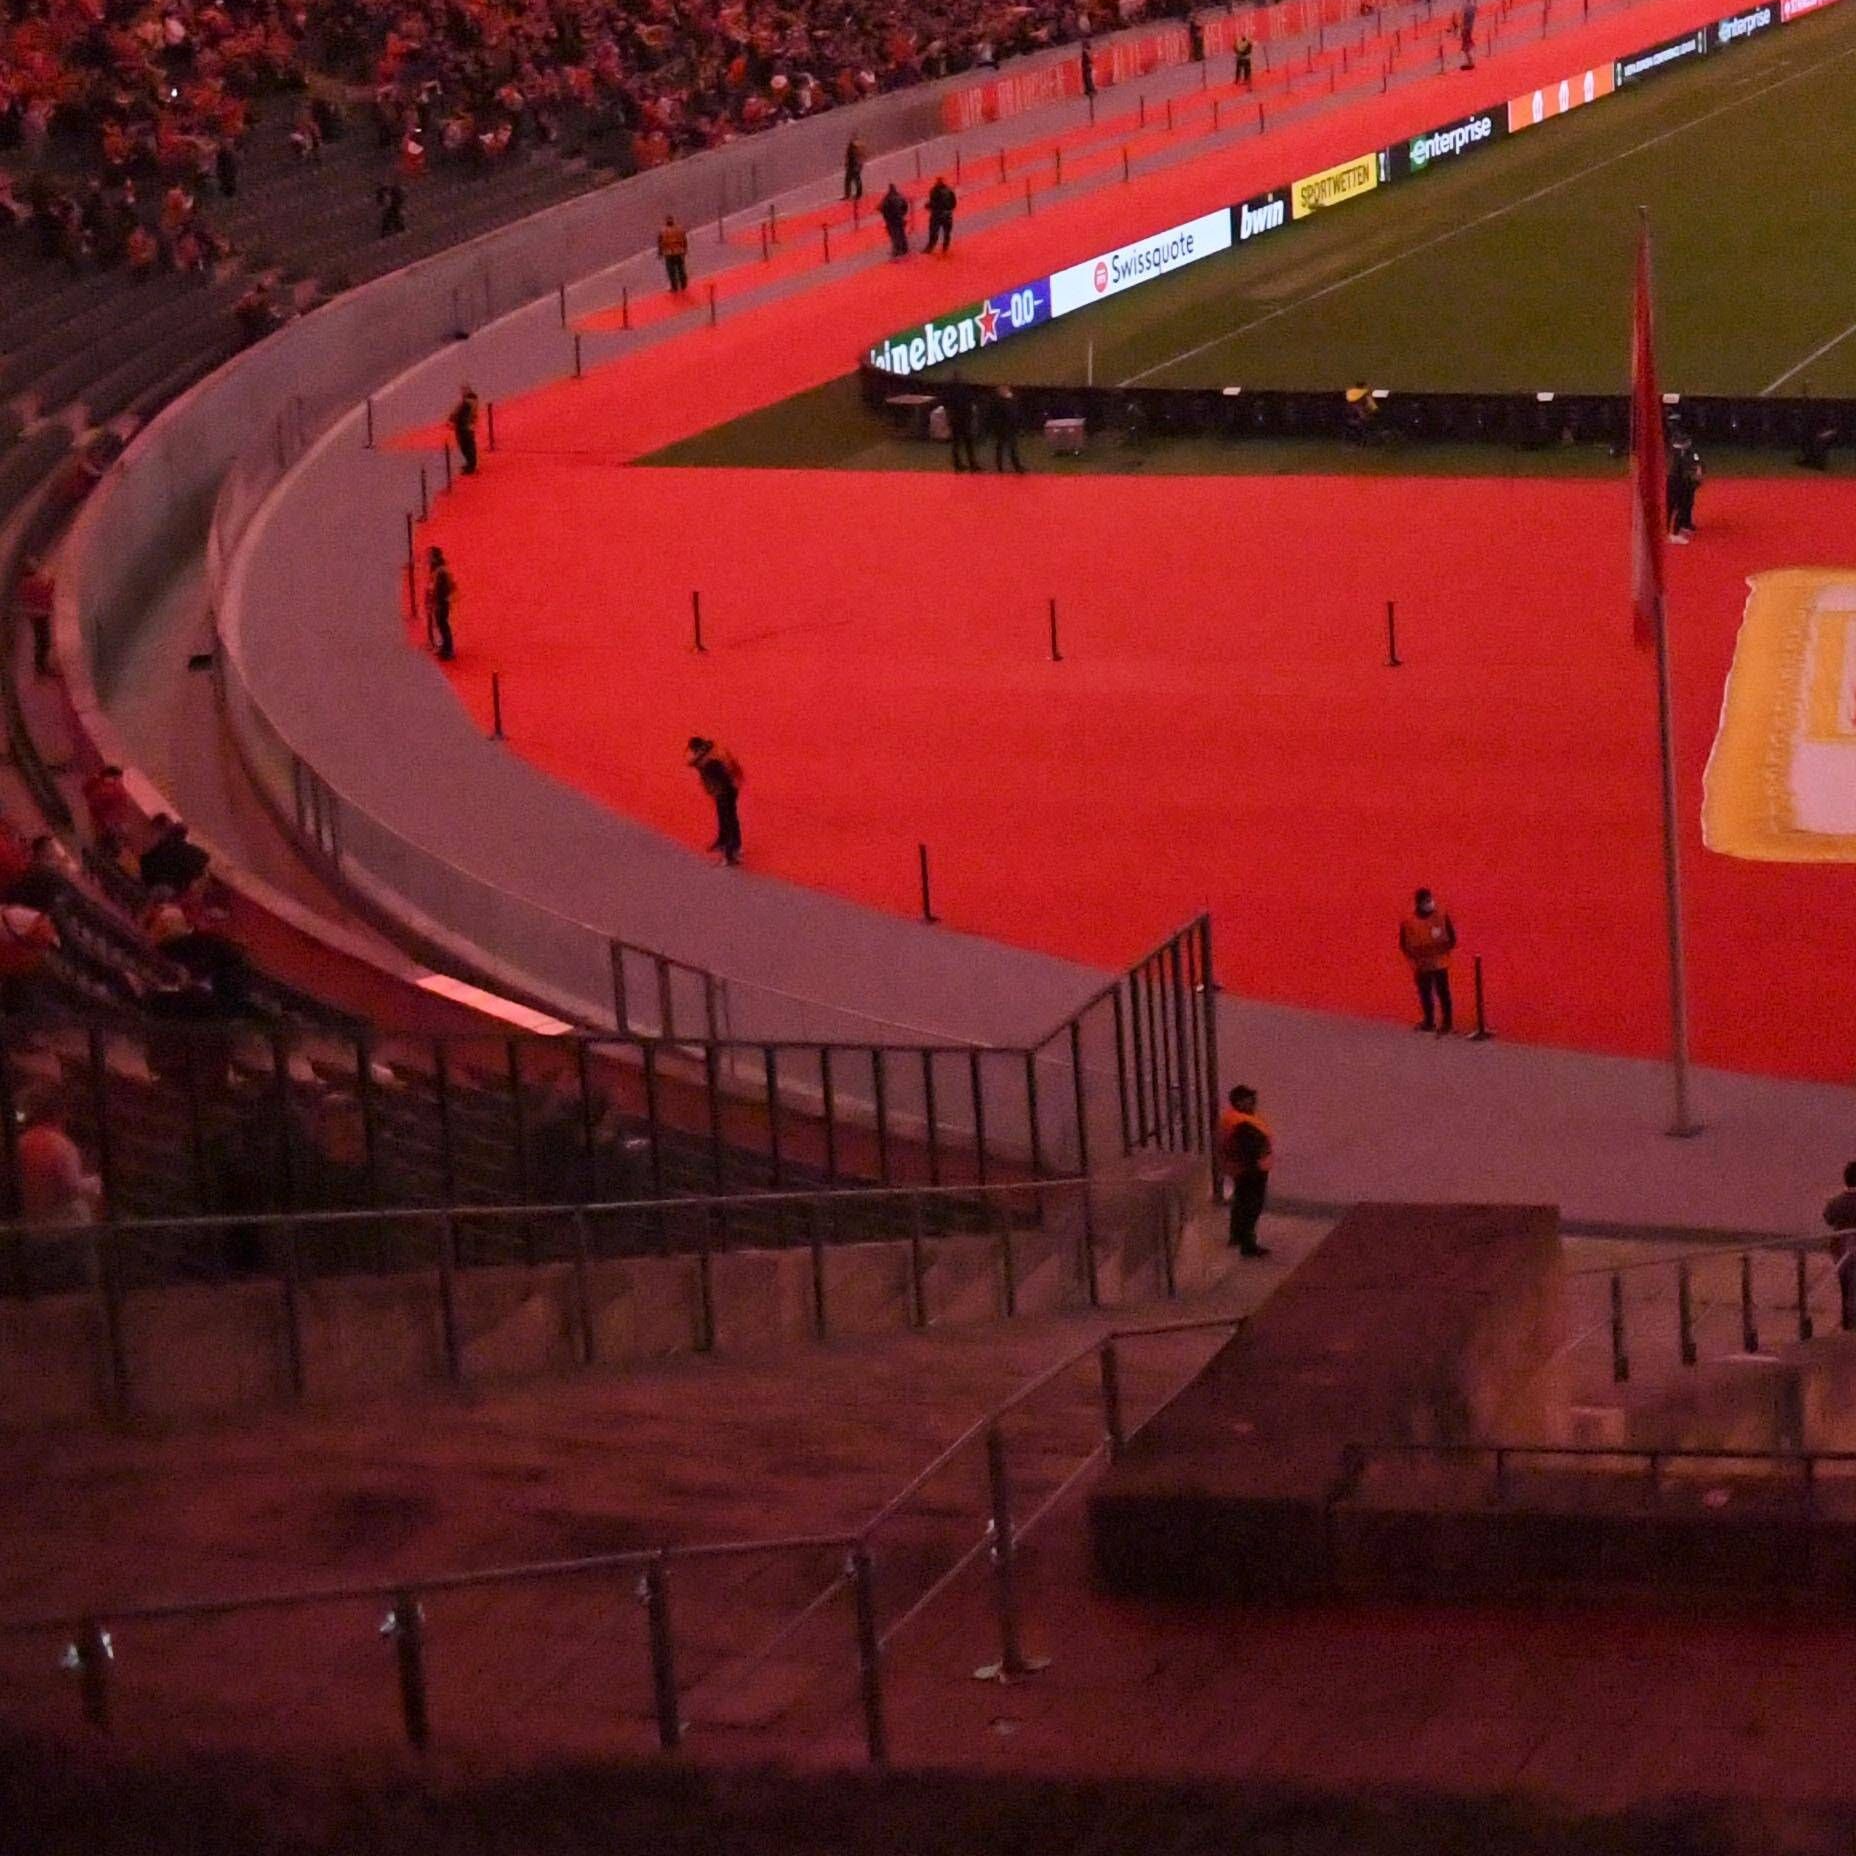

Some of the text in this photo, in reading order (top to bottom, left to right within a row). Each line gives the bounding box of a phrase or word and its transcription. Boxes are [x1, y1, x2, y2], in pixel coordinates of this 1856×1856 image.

[1410, 116, 1492, 165] enterprise
[1240, 162, 1370, 240] bwin SPORTWETTEN
[1112, 232, 1194, 284] Swissquote
